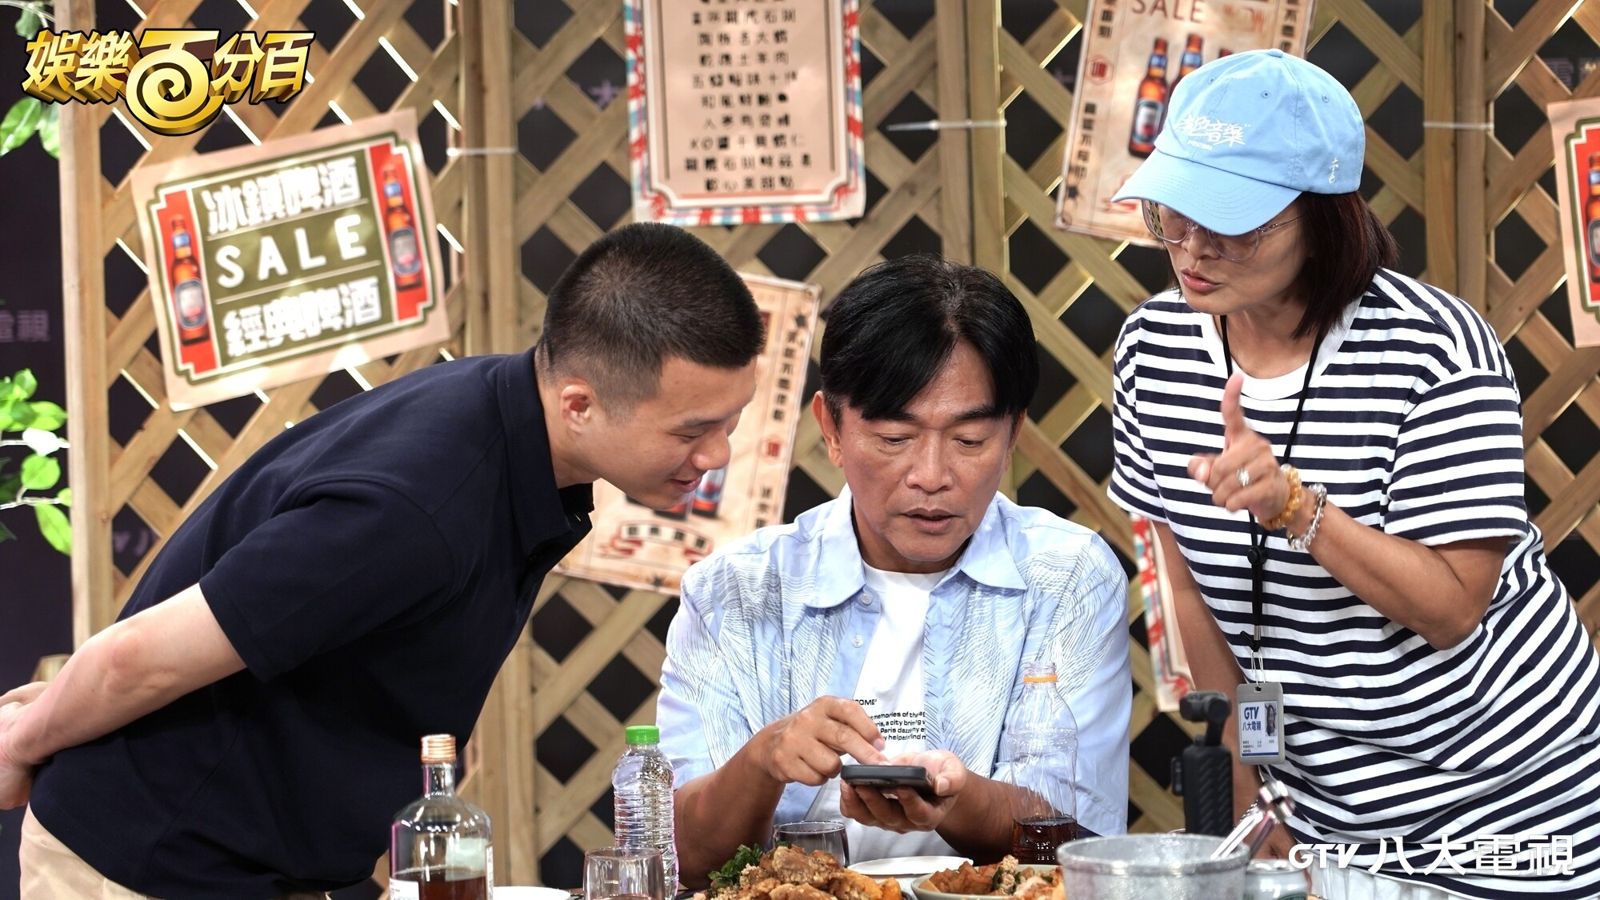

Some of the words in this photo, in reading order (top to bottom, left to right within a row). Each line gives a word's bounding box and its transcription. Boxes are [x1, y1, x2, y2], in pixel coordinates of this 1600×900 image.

[204, 156, 361, 235] 冰鎮啤酒
[215, 214, 368, 288] SALE
[1244, 706, 1260, 720] GTV
